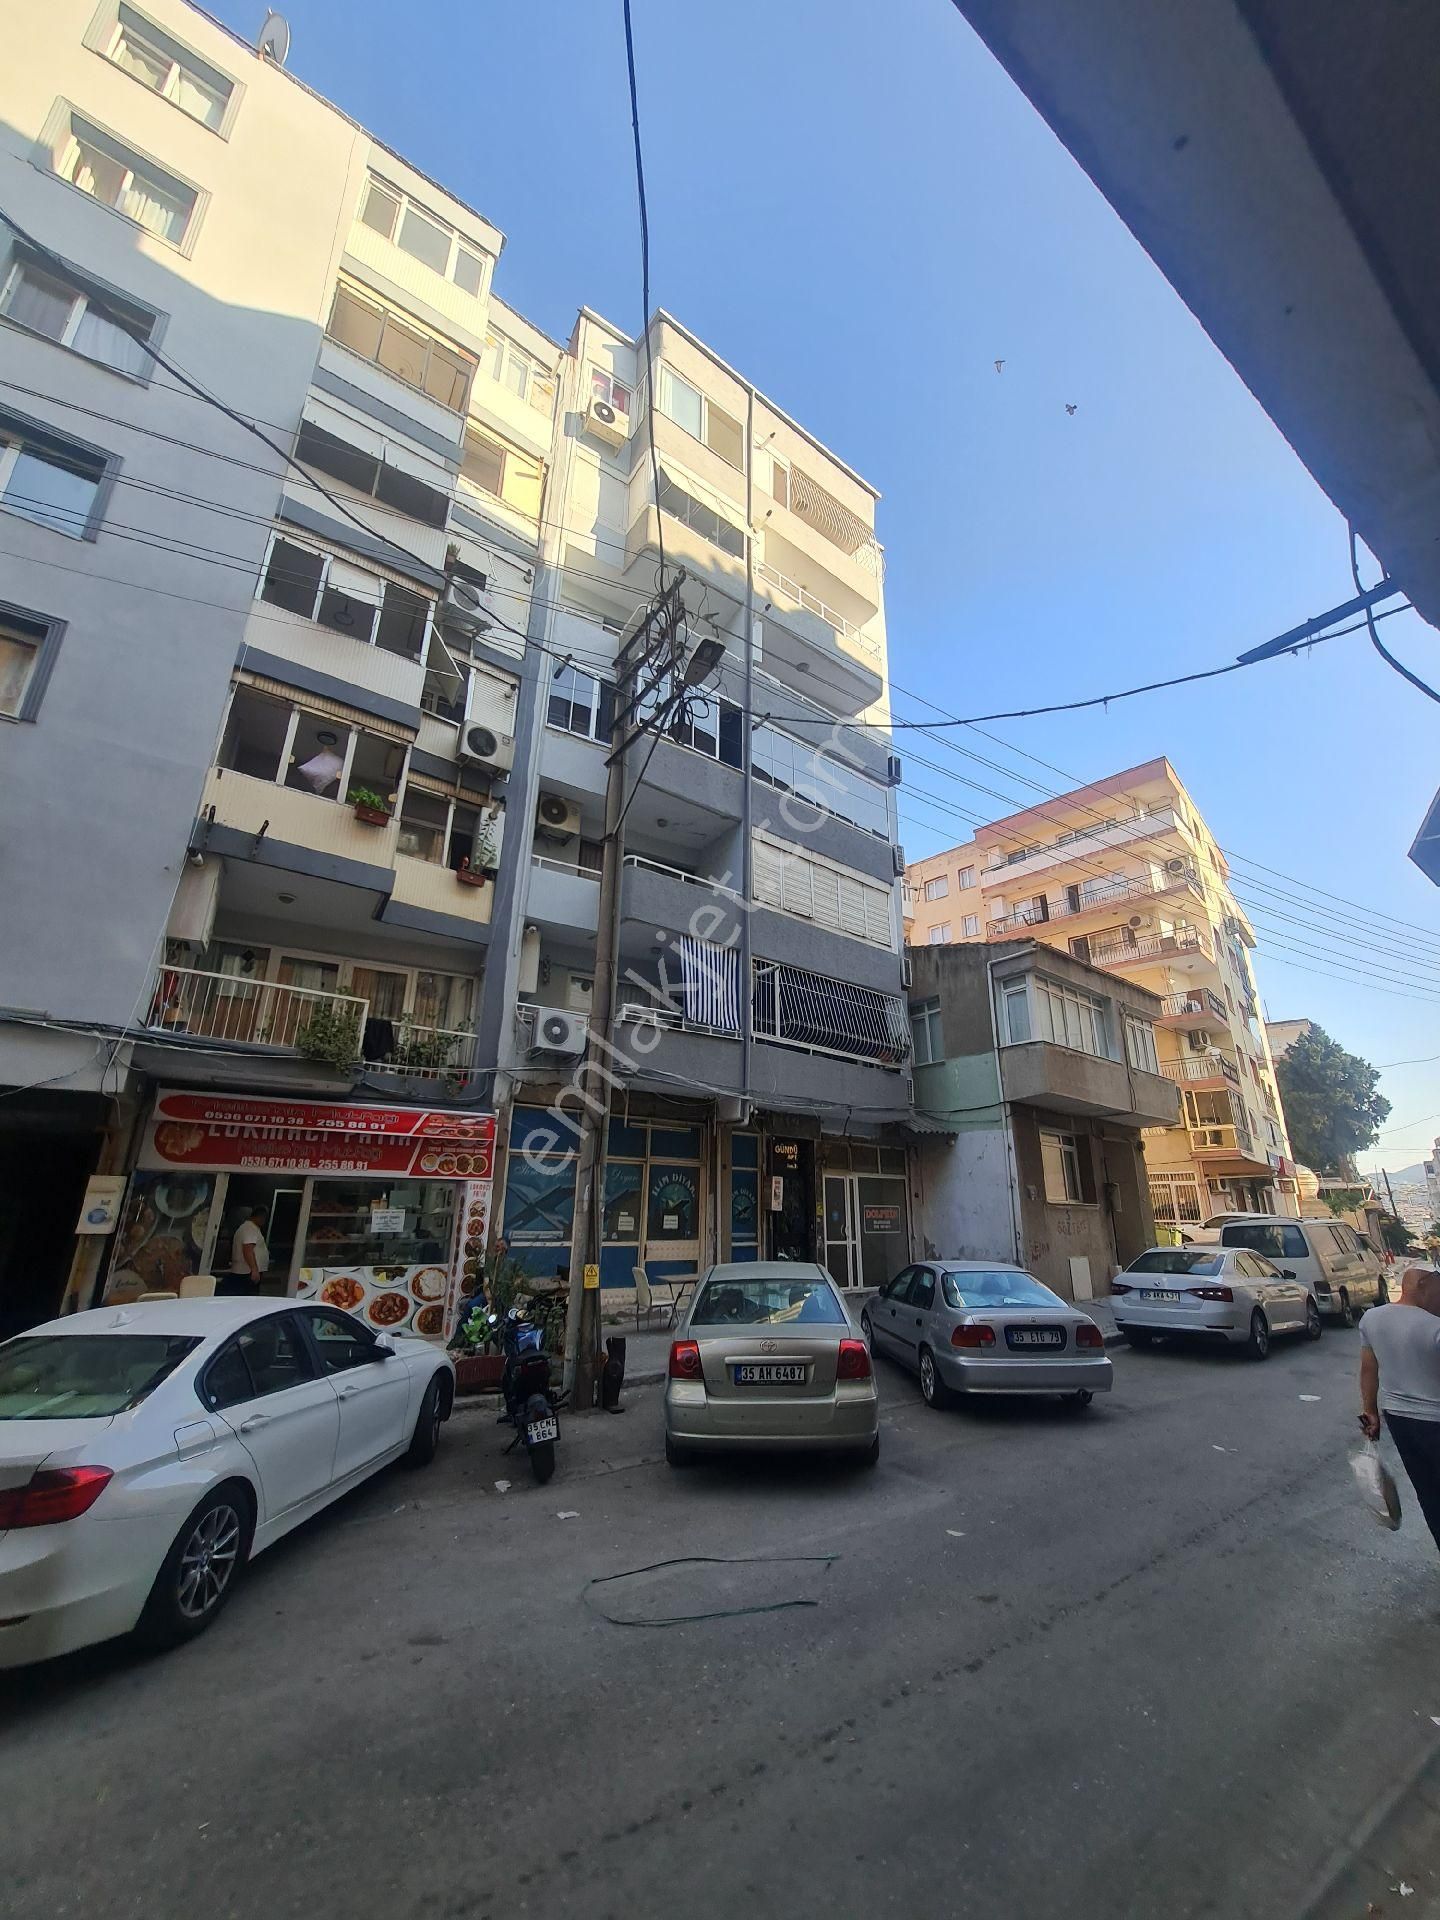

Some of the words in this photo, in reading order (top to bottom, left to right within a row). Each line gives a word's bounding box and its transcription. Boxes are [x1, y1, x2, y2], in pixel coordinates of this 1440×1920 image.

[742, 1367, 755, 1380] 35
[758, 1367, 772, 1380] AH
[527, 1422, 539, 1432] 35
